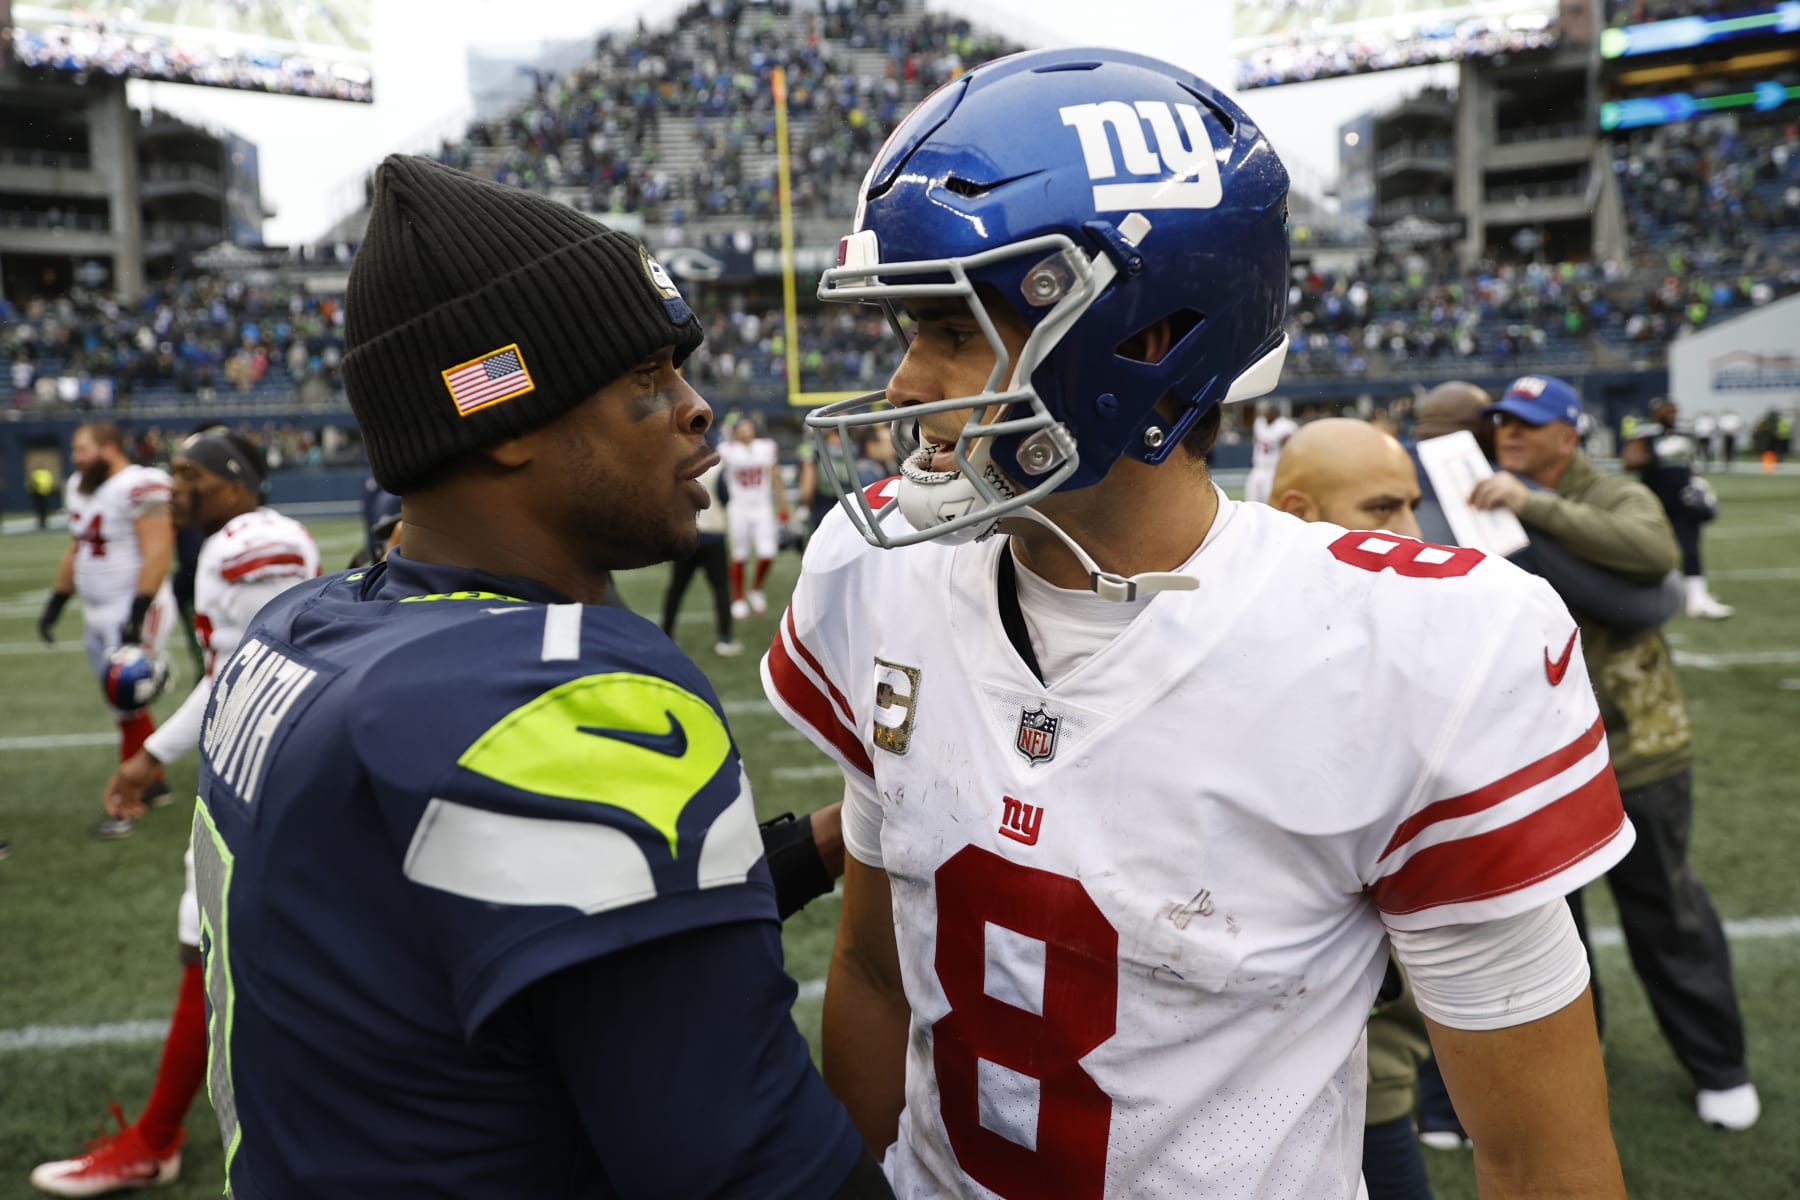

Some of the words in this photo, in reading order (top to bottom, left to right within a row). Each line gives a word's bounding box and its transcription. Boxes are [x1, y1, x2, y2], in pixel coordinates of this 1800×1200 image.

[1328, 530, 1487, 580] 8
[203, 637, 319, 803] SMITH
[873, 663, 912, 729] C
[1020, 728, 1050, 755] NFL
[932, 843, 1119, 1200] 8
